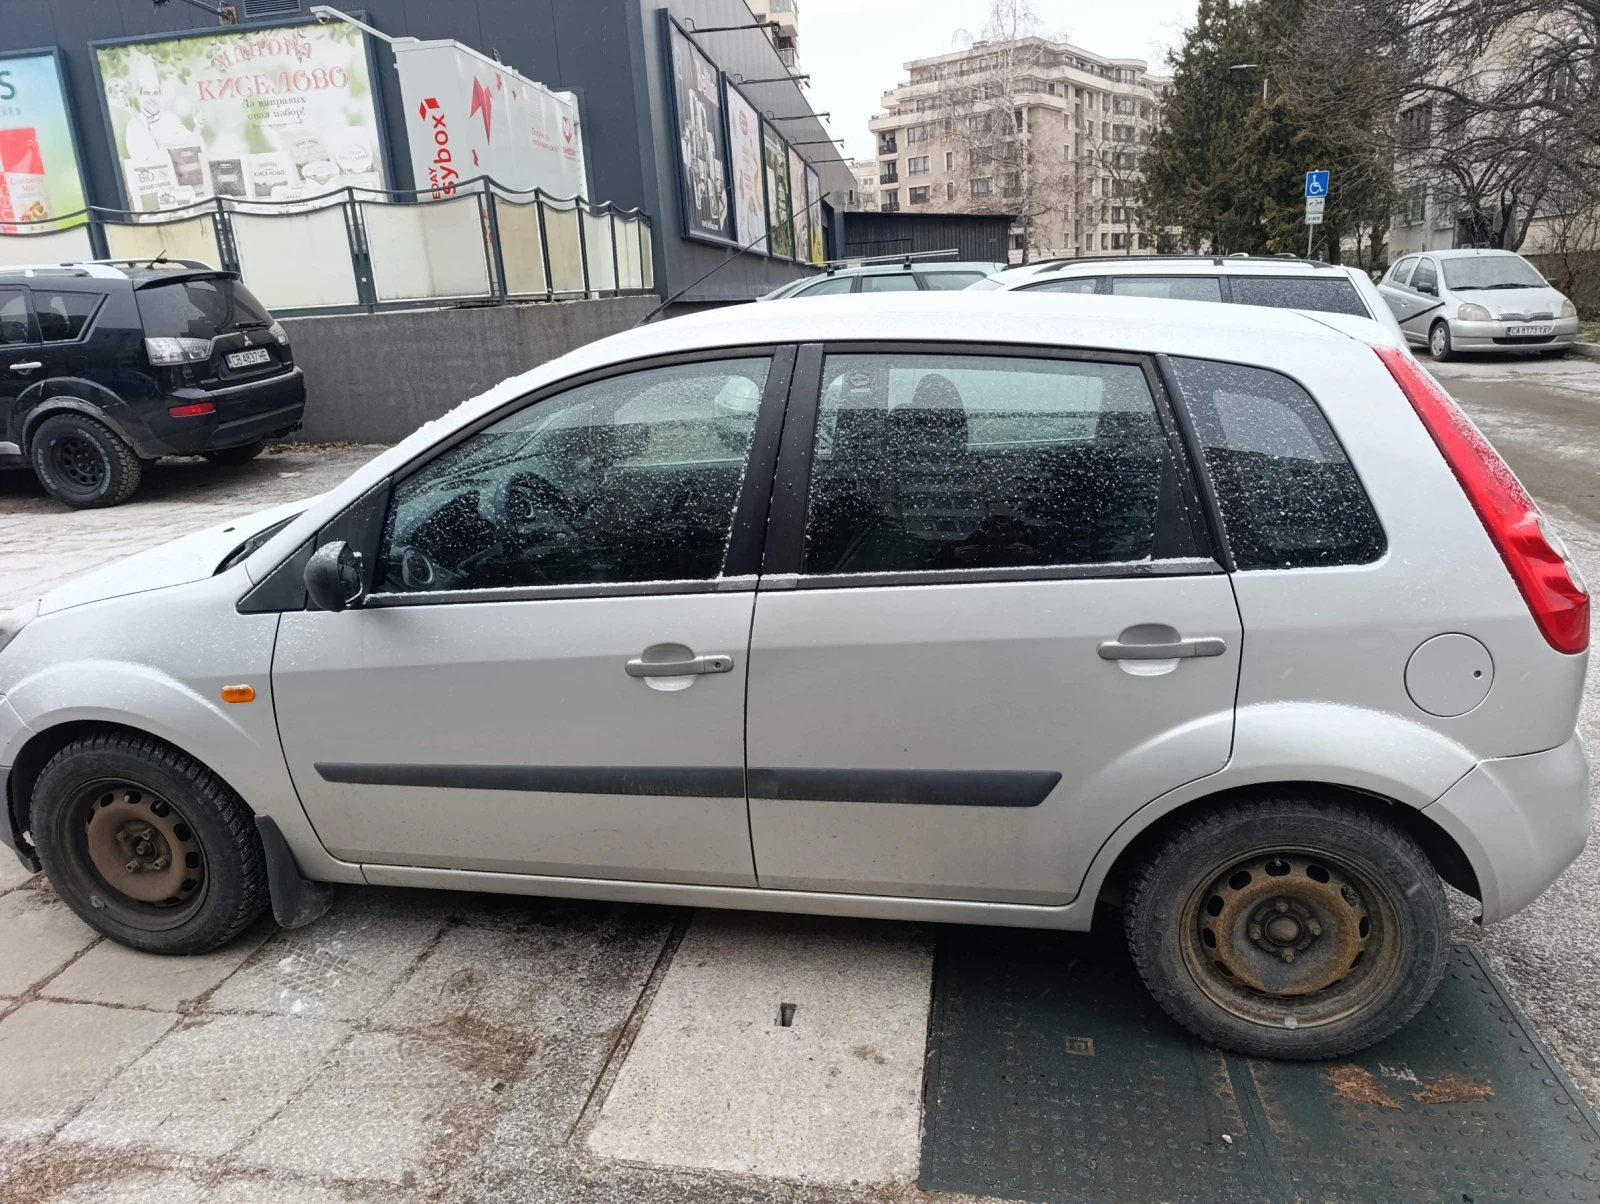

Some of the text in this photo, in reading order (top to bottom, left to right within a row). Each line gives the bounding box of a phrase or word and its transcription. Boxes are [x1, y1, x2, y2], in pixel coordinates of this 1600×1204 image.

[197, 66, 349, 100] КИСЕЛОВО
[257, 96, 306, 108] направих
[247, 107, 306, 120] своя избор!
[254, 169, 285, 177] КИСЕЛОВО
[231, 349, 269, 366] CB 4837 HE
